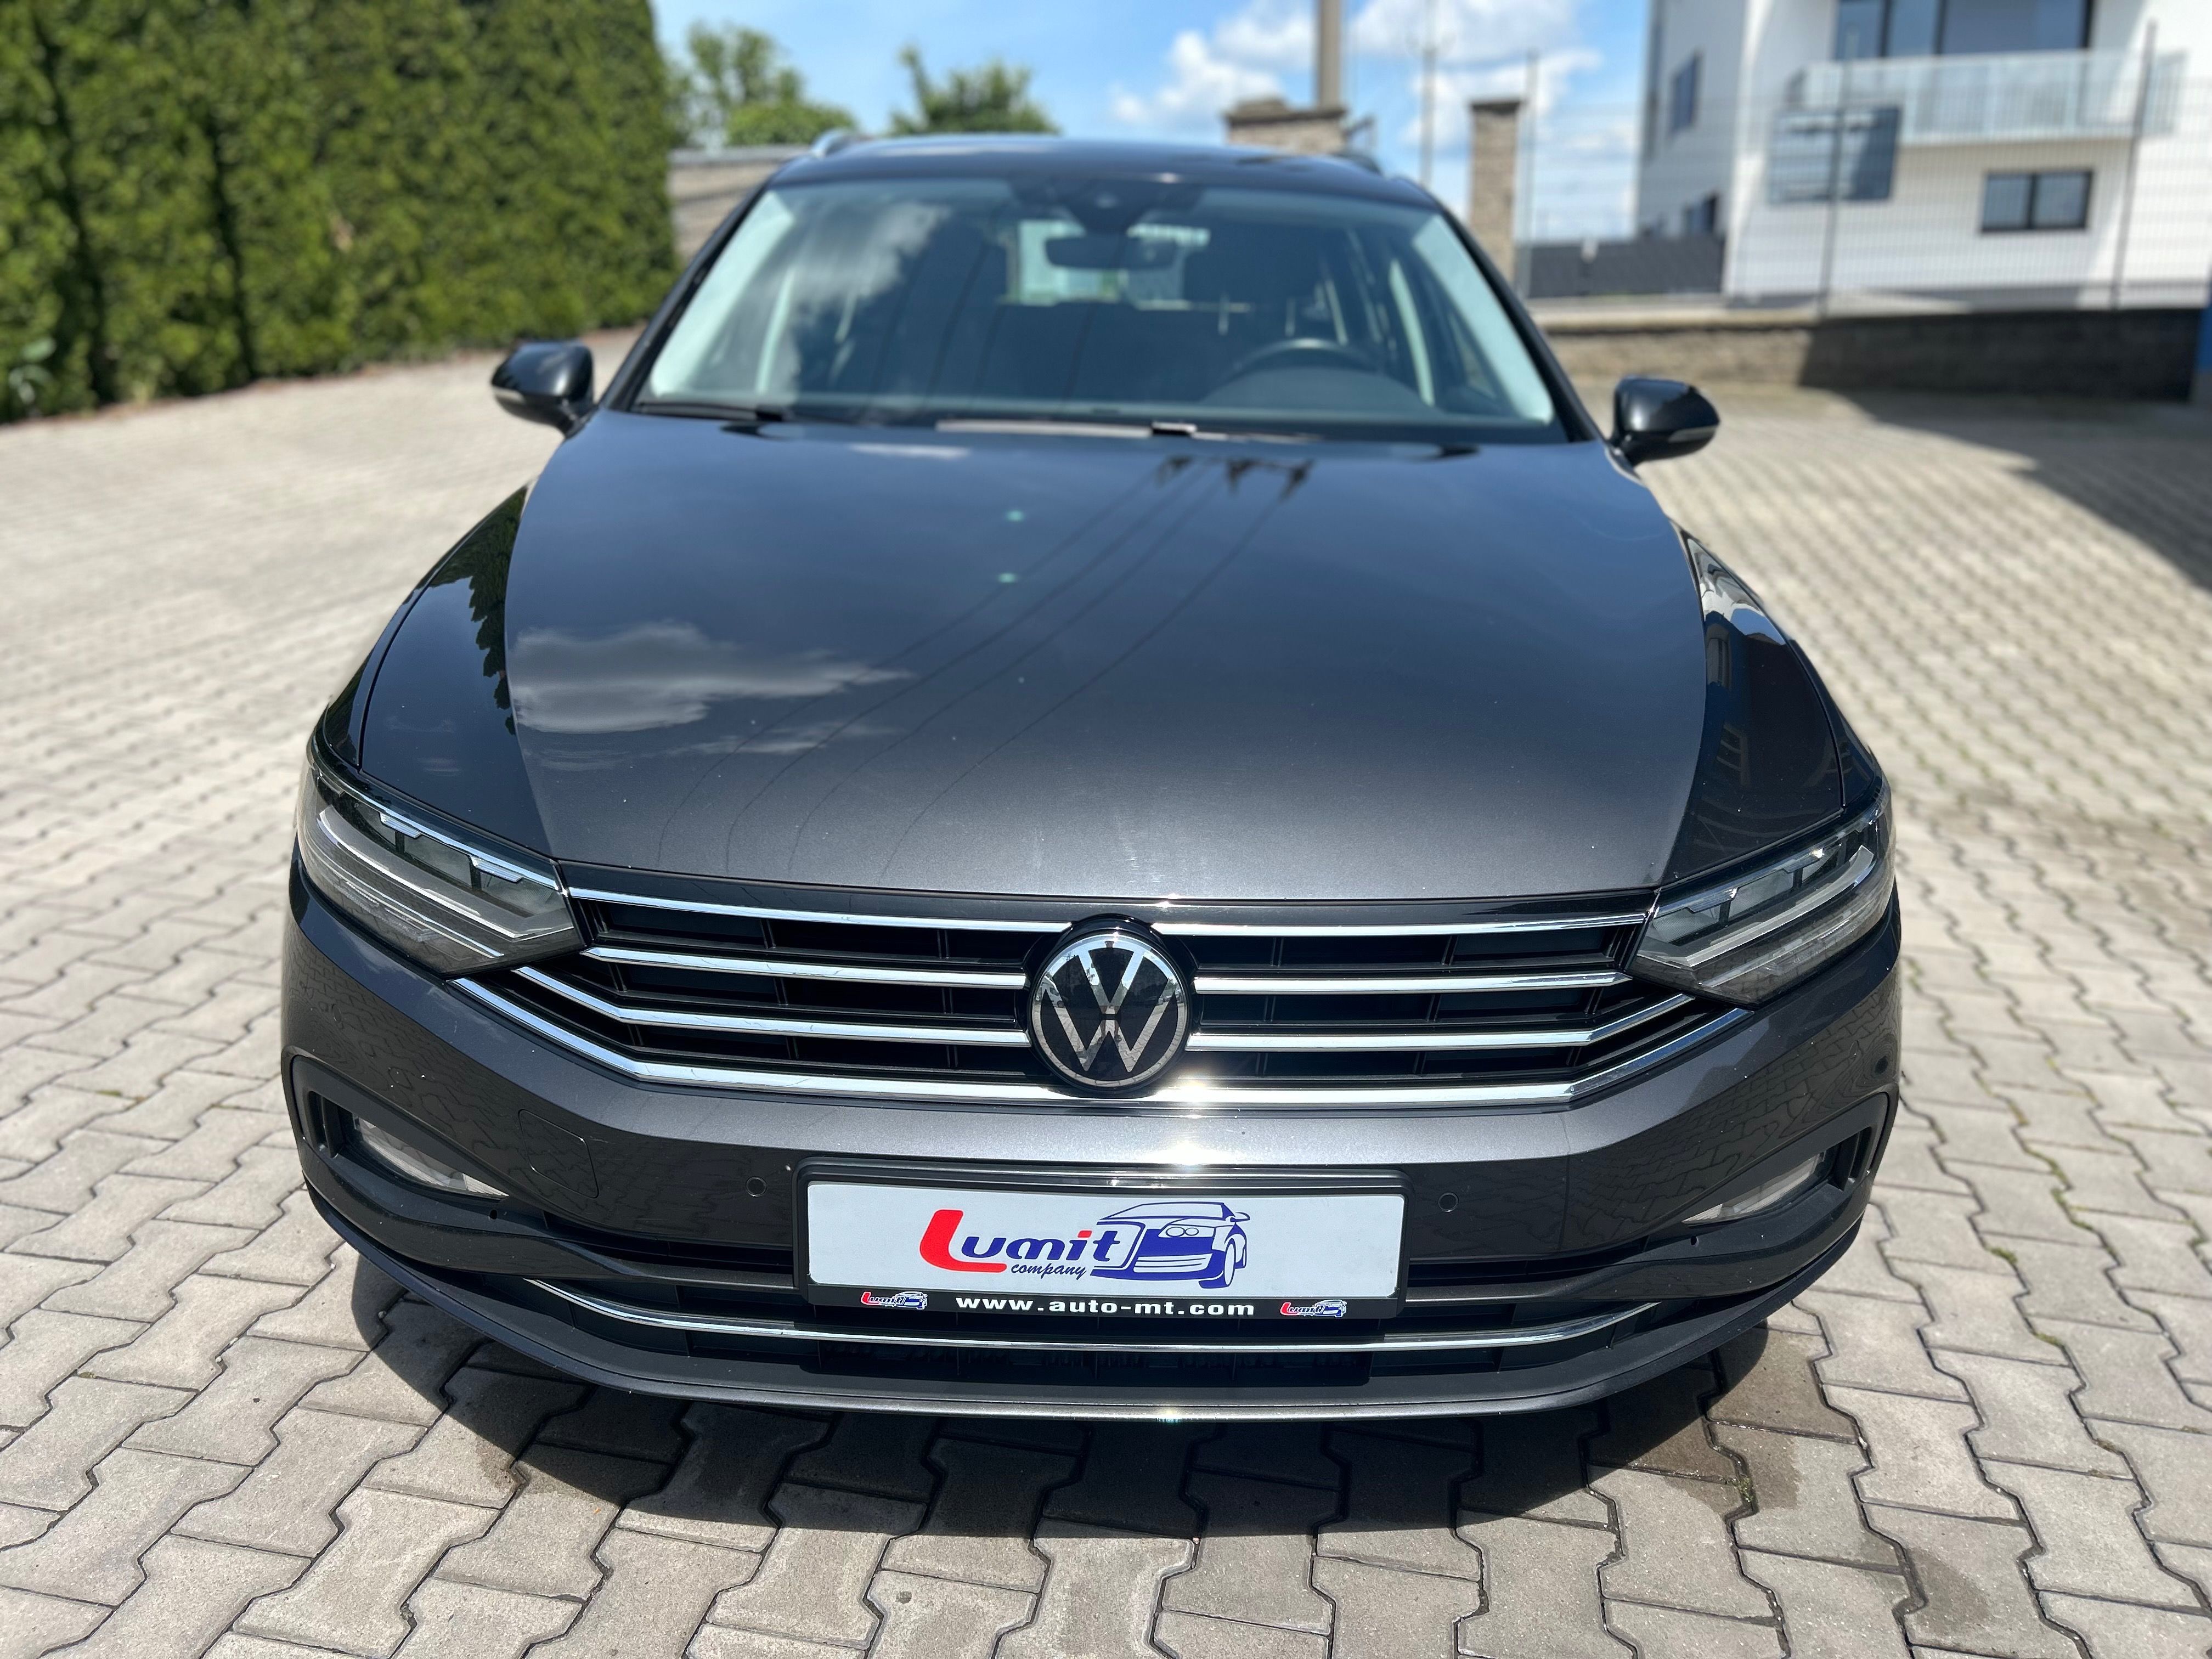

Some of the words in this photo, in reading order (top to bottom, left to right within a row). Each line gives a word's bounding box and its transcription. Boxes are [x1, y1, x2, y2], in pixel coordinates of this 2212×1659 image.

[919, 1209, 1120, 1273] Lumit
[1011, 1263, 1087, 1280] company
[956, 1297, 1254, 1316] www.auto-mt.com
